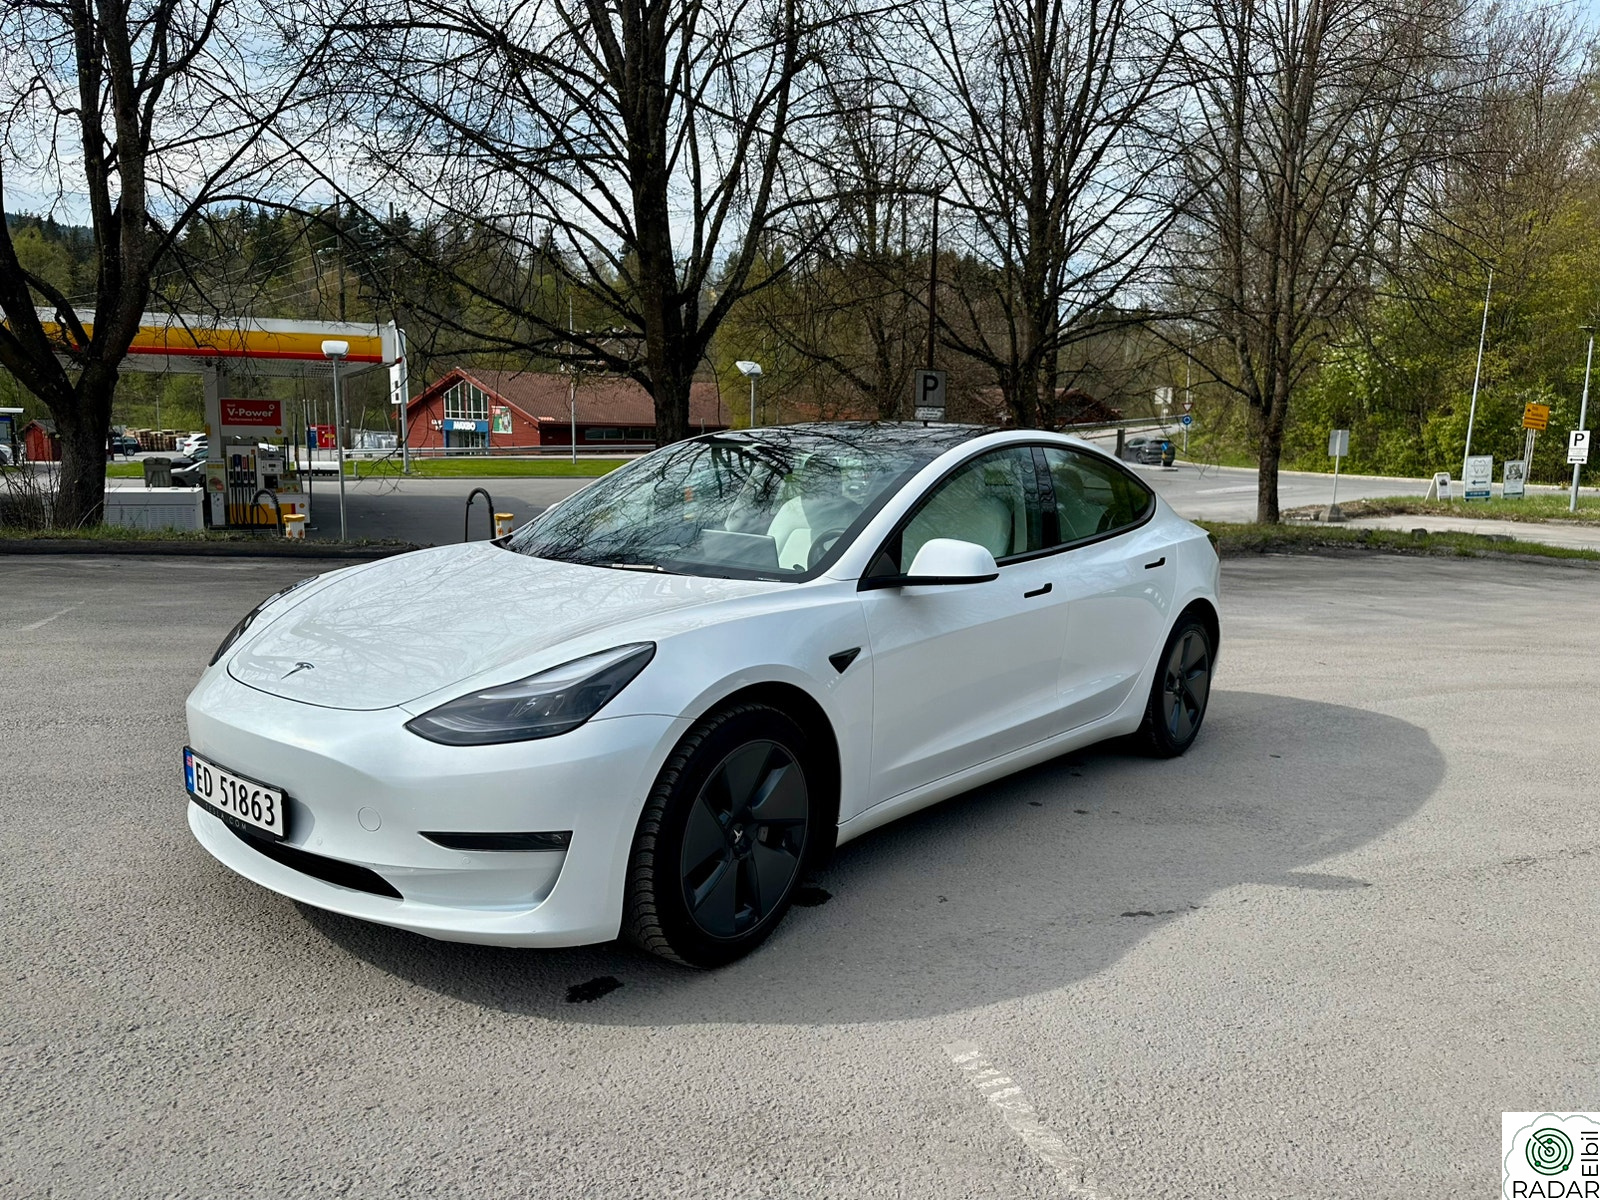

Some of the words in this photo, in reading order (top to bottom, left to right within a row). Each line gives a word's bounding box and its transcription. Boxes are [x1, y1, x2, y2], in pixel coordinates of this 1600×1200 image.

[922, 375, 938, 401] P
[227, 408, 273, 417] V-Power
[1574, 433, 1585, 446] P
[195, 762, 212, 797] ED
[220, 776, 275, 826] 51863
